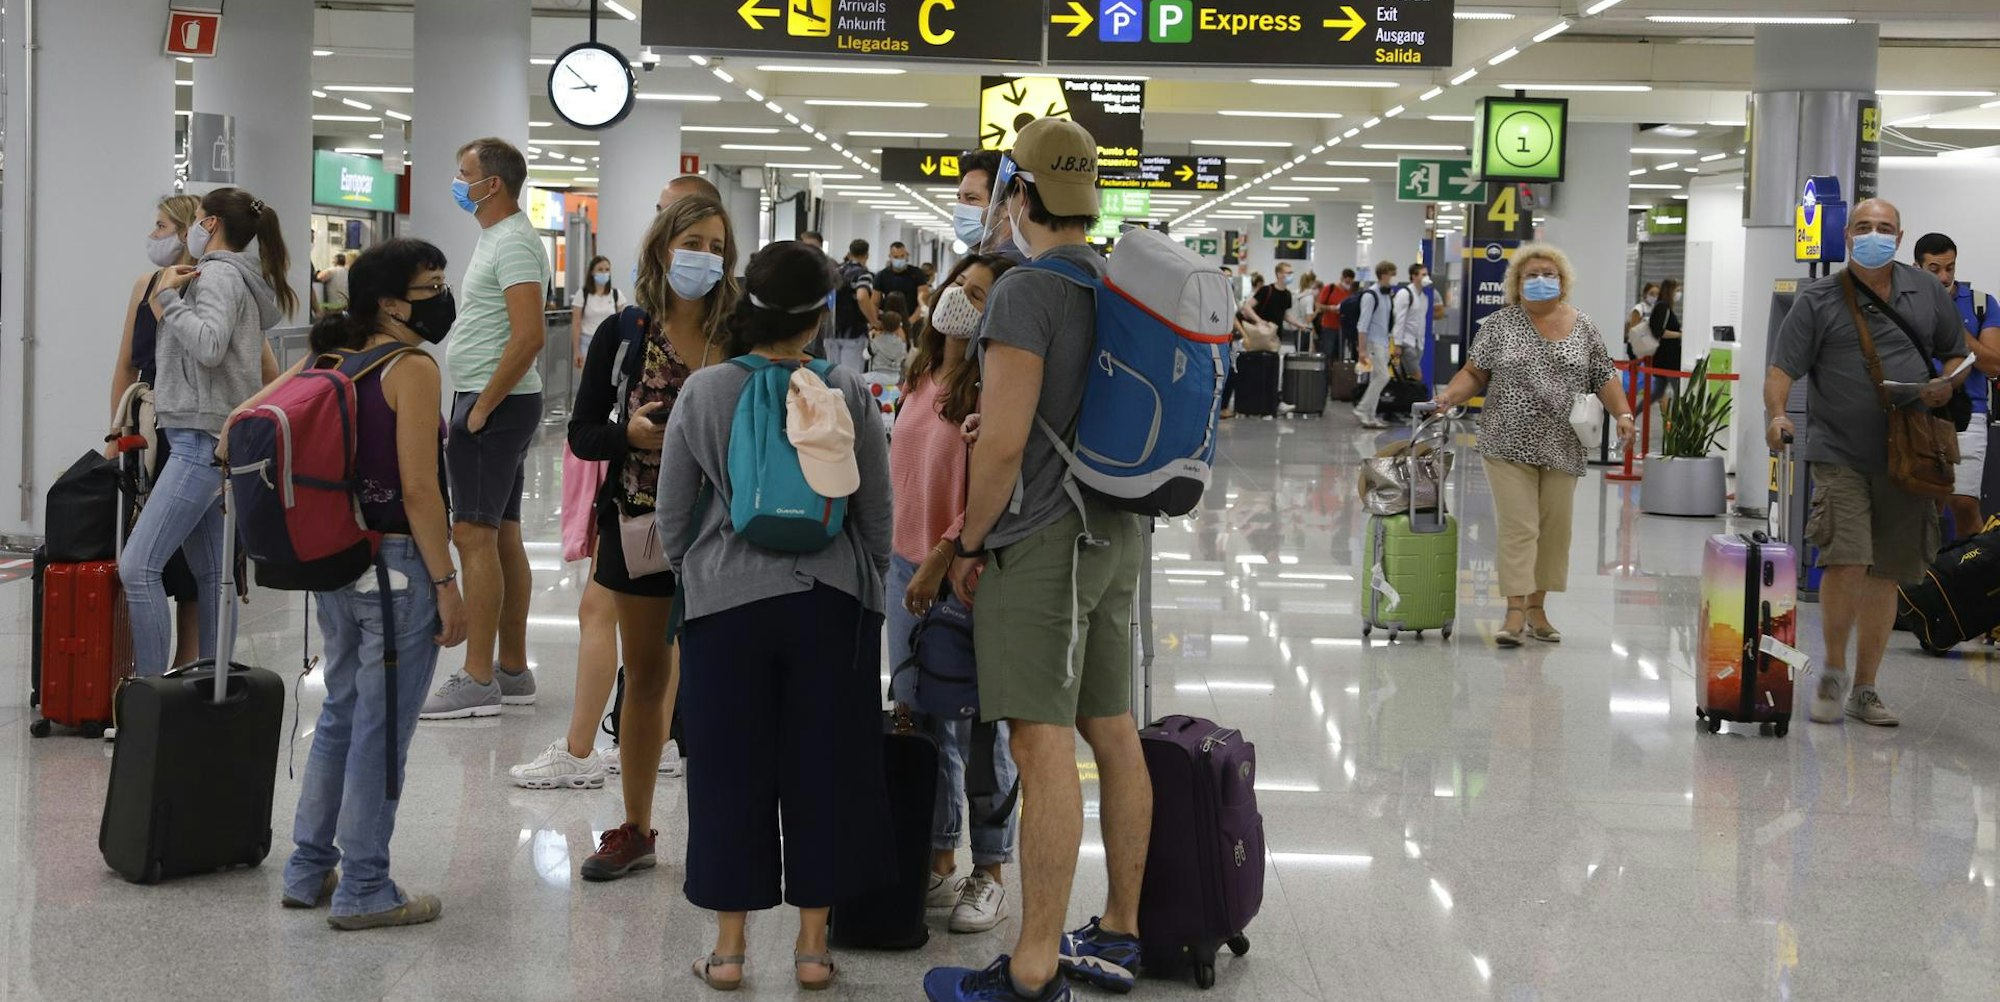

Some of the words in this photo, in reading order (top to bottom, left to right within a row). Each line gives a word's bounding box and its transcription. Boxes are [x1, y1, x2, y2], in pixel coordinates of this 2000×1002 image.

[838, 0, 886, 13] Arrivals
[1376, 6, 1398, 22] Exit
[837, 16, 886, 31] Ankunft
[918, 0, 956, 46] C
[1159, 4, 1184, 38] P
[1199, 8, 1302, 36] Express
[837, 34, 910, 53] Llegadas
[1375, 27, 1426, 46] Ausgang
[1375, 48, 1422, 64] Salida
[1064, 80, 1089, 91] Punt
[1089, 82, 1103, 91] de
[1121, 93, 1141, 104] point
[1096, 145, 1125, 156] Punto
[1125, 147, 1139, 156] de
[1097, 158, 1138, 167] ncuentro
[341, 167, 374, 196] Europcar
[1100, 179, 1140, 187] Facturación
[1141, 180, 1146, 188] y
[1147, 180, 1172, 188] salidas
[1196, 182, 1219, 190] Salida
[1487, 186, 1520, 232] 4
[1797, 228, 1806, 243] 24
[1479, 281, 1506, 292] ATM
